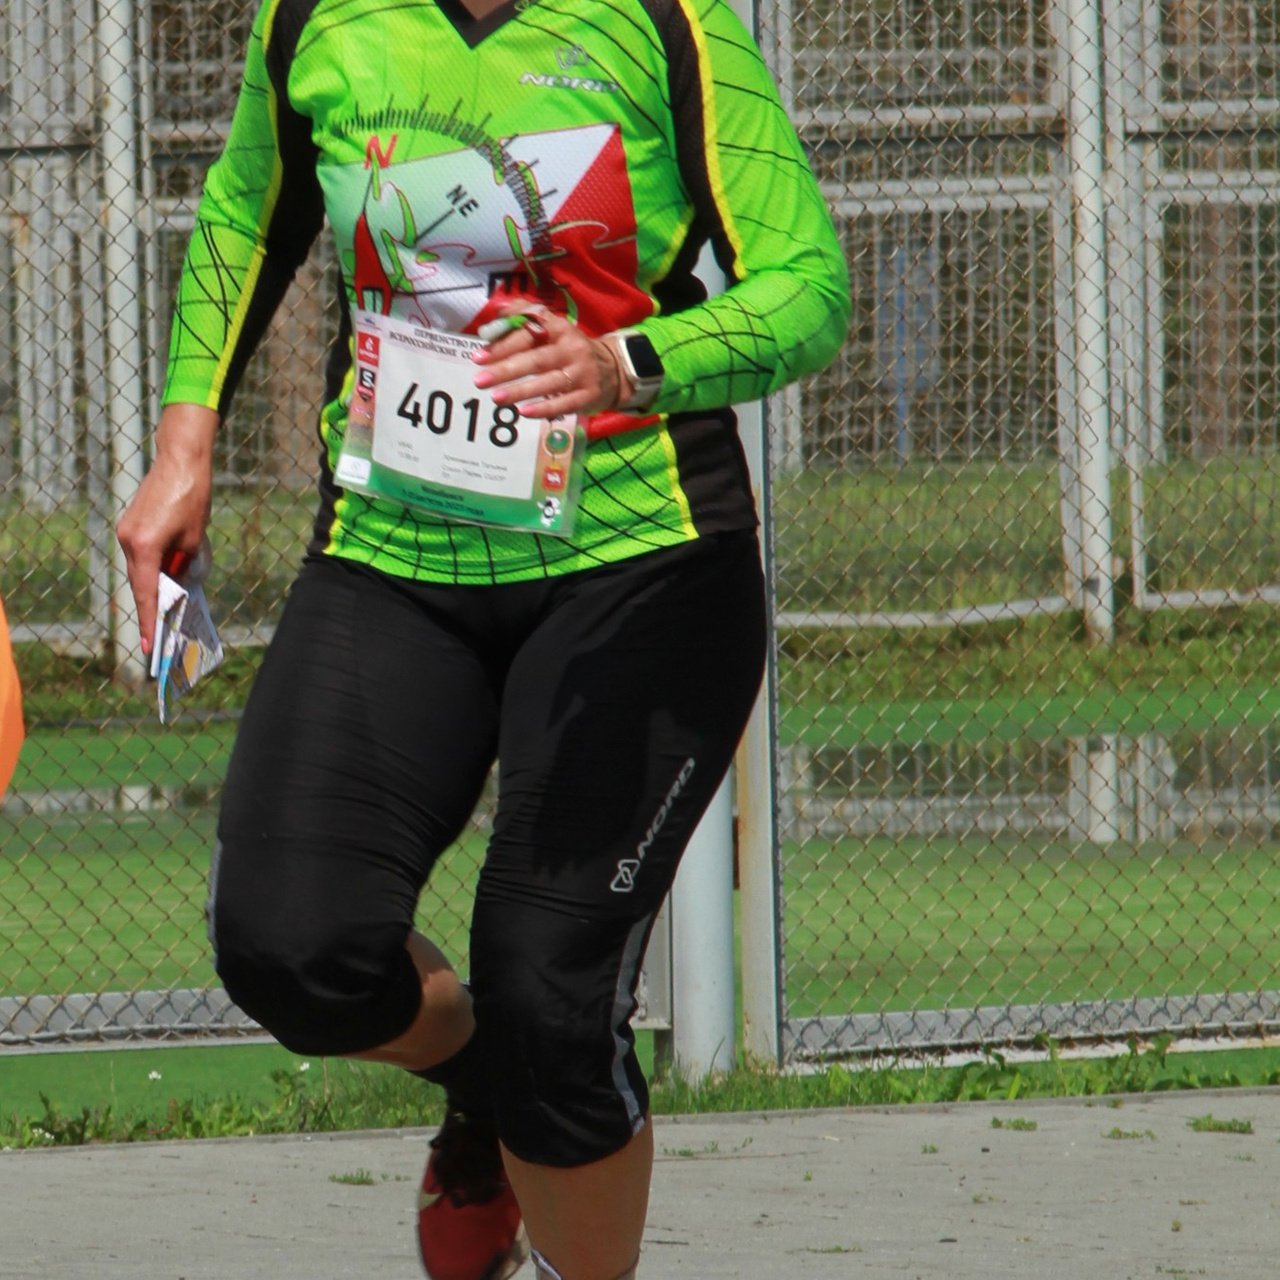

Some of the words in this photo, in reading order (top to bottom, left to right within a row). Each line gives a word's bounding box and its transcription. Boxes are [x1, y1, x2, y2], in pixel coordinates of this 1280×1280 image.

[519, 72, 619, 93] NORD
[445, 183, 479, 219] NE
[397, 382, 519, 447] 4018
[637, 757, 696, 859] NORD
